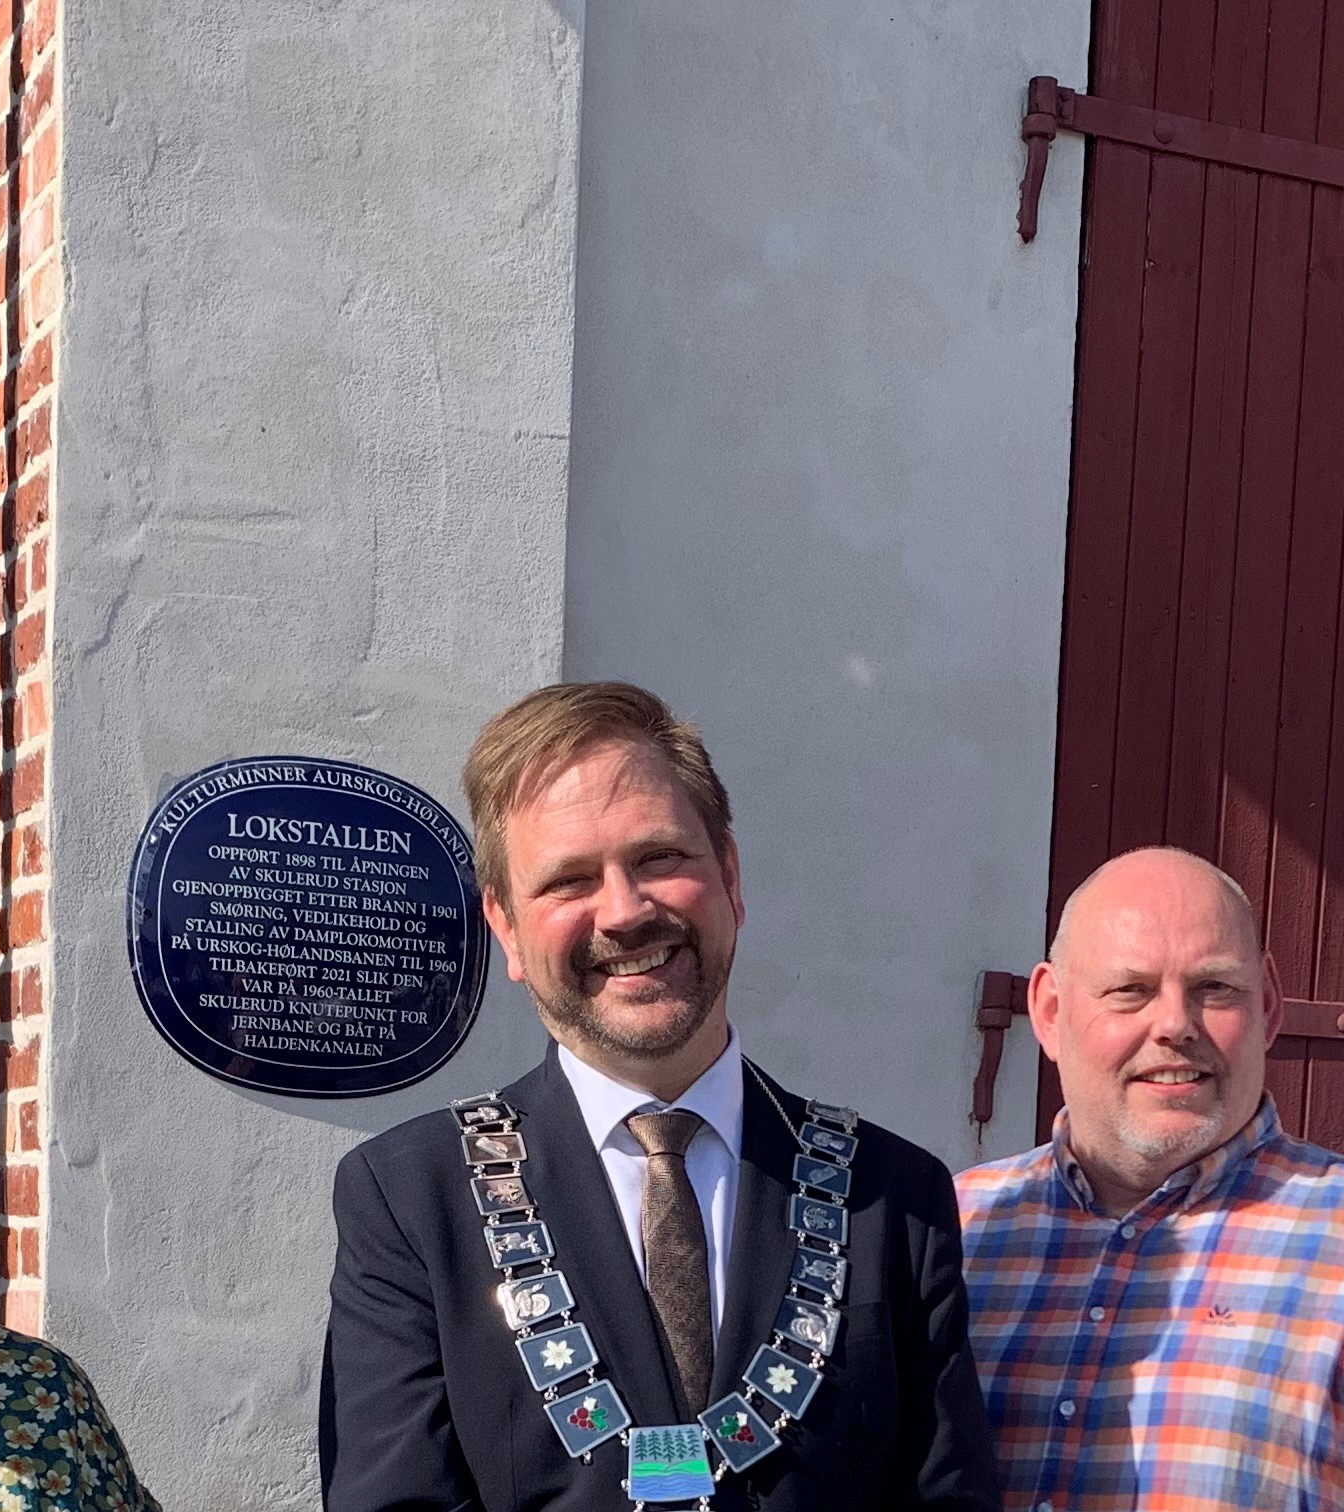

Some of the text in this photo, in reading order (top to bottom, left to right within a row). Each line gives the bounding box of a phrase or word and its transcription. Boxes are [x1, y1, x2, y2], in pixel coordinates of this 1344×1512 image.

[159, 767, 470, 865] KULTURMINNER AURSKOG-HØLAND
[227, 812, 411, 854] LOKSTALLEN
[208, 845, 429, 880] OPPFØRT 1898 TIL ÅPNINGEN
[228, 866, 407, 896] AV SKULERUD STASJON
[172, 880, 457, 919] GJENOPPBYGGET ETTER BRANN I 1901
[210, 901, 427, 934] SMØRING, VEDLIKEHOLD OG
[185, 918, 446, 954] STALLING AV DAMPLOKOMOTIVER
[171, 933, 457, 973] PÅ URSKOG-HØLANDSBANEN TIL 1960
[209, 957, 423, 988] TILBAKEFØRT 2021 SLIK DEN
[241, 979, 393, 1003] VAR PÅ 1960-TALLET
[199, 993, 428, 1025] SKULERUD KNUTEPUNKT FOR
[231, 1015, 396, 1040] JERNBANE OG BÅT PÅ
[244, 1034, 383, 1056] HALDENKANALEN
